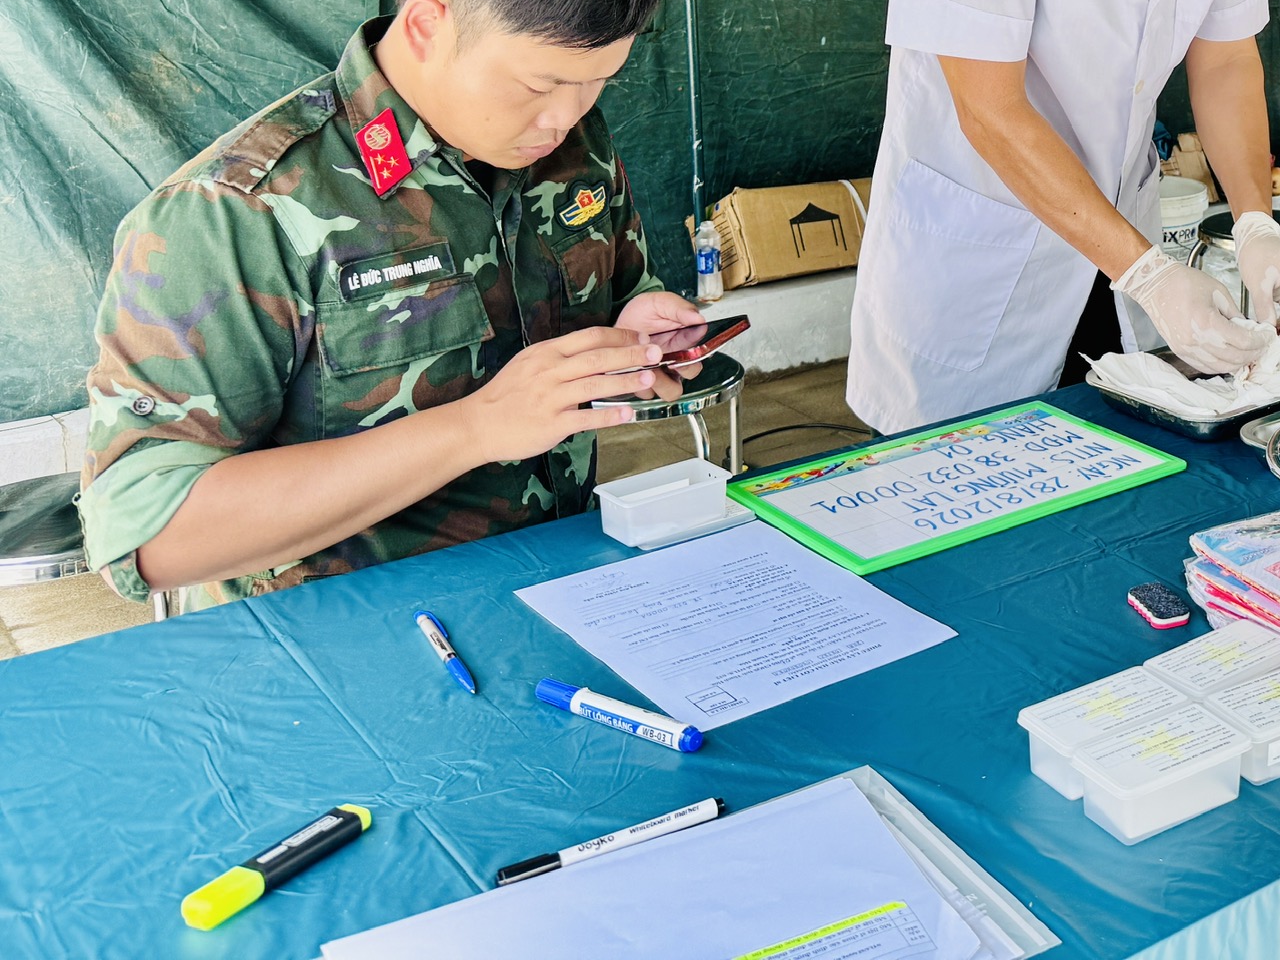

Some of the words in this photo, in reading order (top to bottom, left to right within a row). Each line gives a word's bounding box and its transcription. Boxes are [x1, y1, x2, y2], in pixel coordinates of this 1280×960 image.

[347, 273, 361, 290] LÊ
[361, 268, 382, 287] ĐỨC
[382, 263, 414, 282] TRUNG
[413, 254, 442, 274] NGHĨA
[931, 442, 973, 458] 01
[1043, 442, 1113, 464] NTLS:
[592, 710, 612, 726] LÔNG
[612, 714, 633, 733] BẢNG
[642, 727, 666, 742] WB-03
